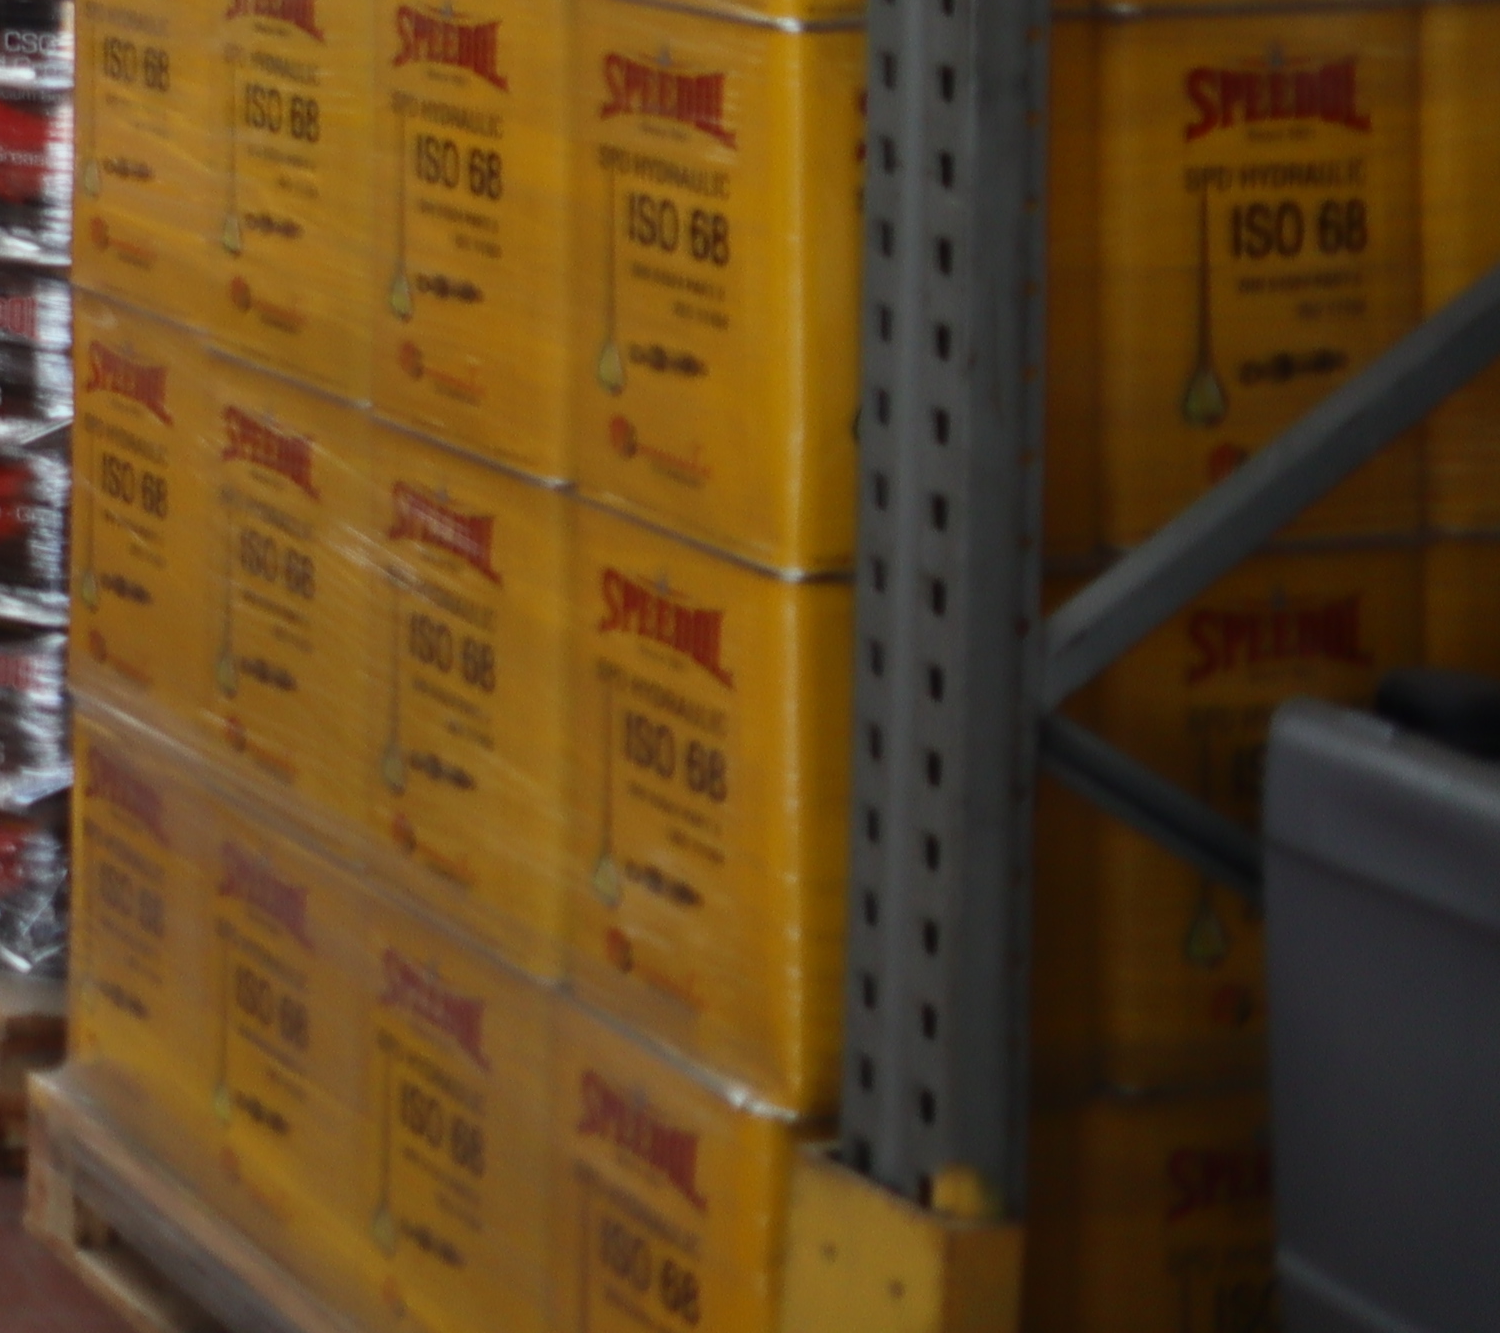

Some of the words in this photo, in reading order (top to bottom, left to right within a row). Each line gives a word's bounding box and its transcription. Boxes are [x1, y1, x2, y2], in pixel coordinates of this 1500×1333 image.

[103, 35, 137, 84] ISO
[141, 43, 171, 94] 68
[392, 2, 510, 94] SPEEDOL
[245, 79, 283, 134] ISO
[289, 92, 321, 145] 68
[599, 50, 739, 152] SPEEDOL
[1183, 53, 1373, 143] SPEEDOL
[415, 131, 461, 189] ISO
[468, 148, 505, 202] 68
[632, 150, 731, 203] HYDRAULIC
[627, 189, 681, 255] ISO
[688, 209, 731, 269] 68
[1230, 200, 1304, 262] ISO
[1317, 196, 1369, 256] 68
[102, 449, 137, 505] ISO
[140, 467, 169, 522] 68
[408, 609, 455, 676] ISO
[462, 636, 497, 695] 68
[599, 566, 736, 691] SPEEDOL
[623, 709, 677, 780] ISO
[684, 736, 729, 806] 68
